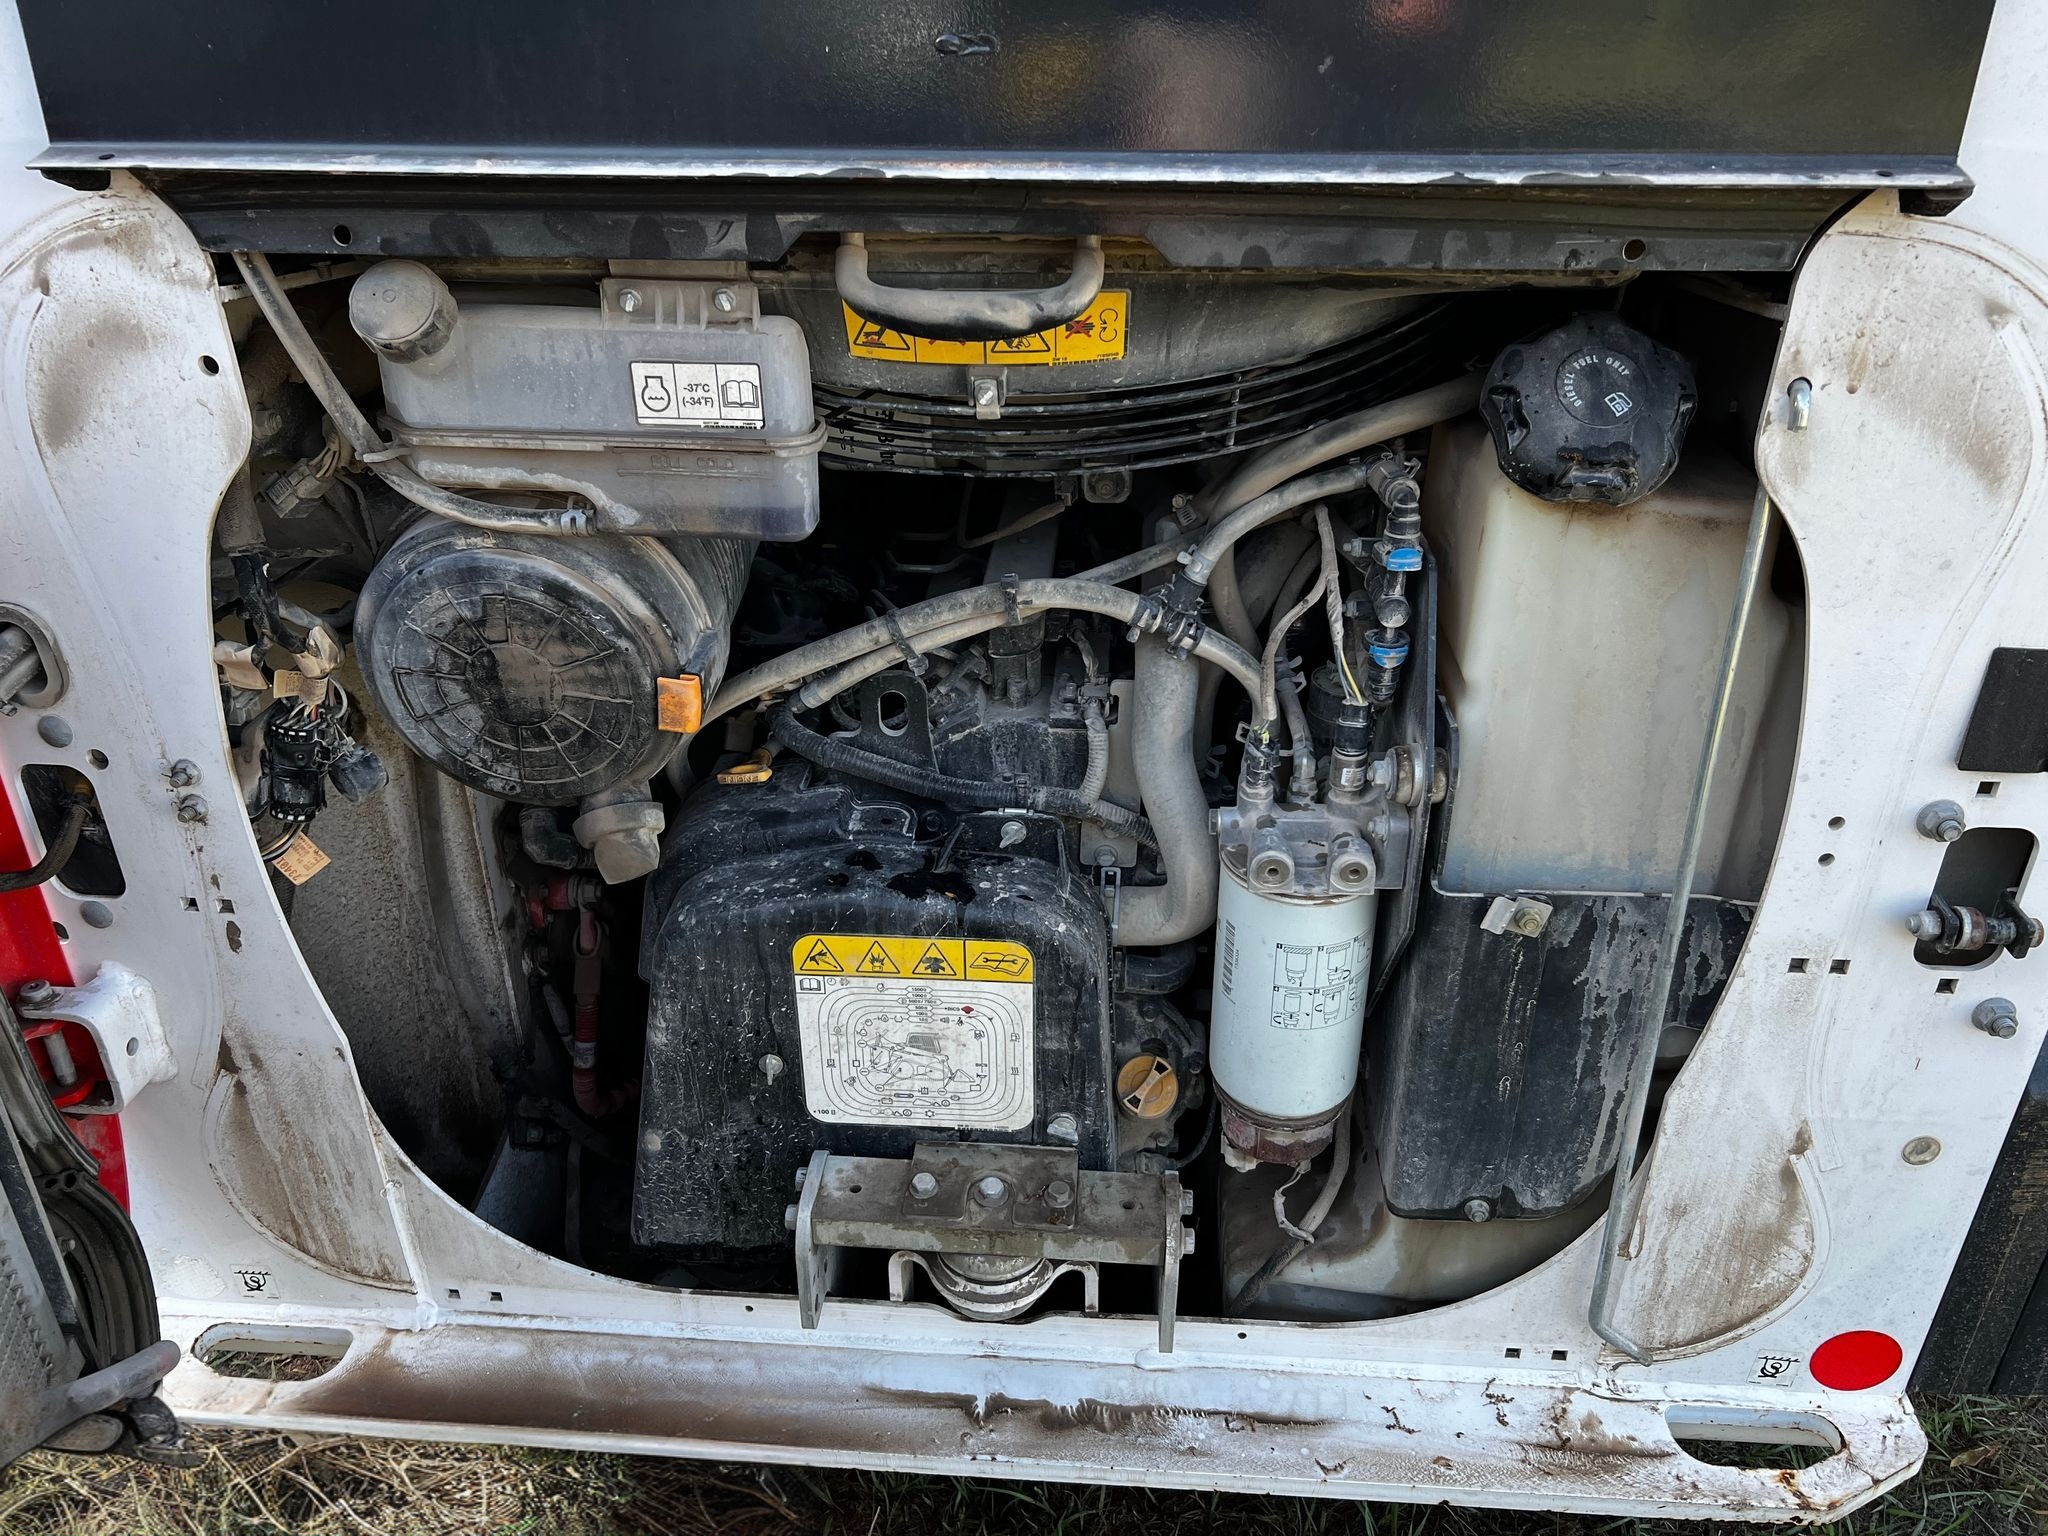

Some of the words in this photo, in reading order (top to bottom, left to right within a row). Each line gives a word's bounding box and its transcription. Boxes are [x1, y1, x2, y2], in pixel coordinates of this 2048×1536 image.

[1563, 373, 1582, 407] DIESEL
[1573, 354, 1599, 370] FUEL
[1605, 356, 1630, 376] ONLY
[683, 382, 711, 393] -37°C
[682, 396, 714, 408] (-34°F)
[720, 774, 759, 783] ENGINE
